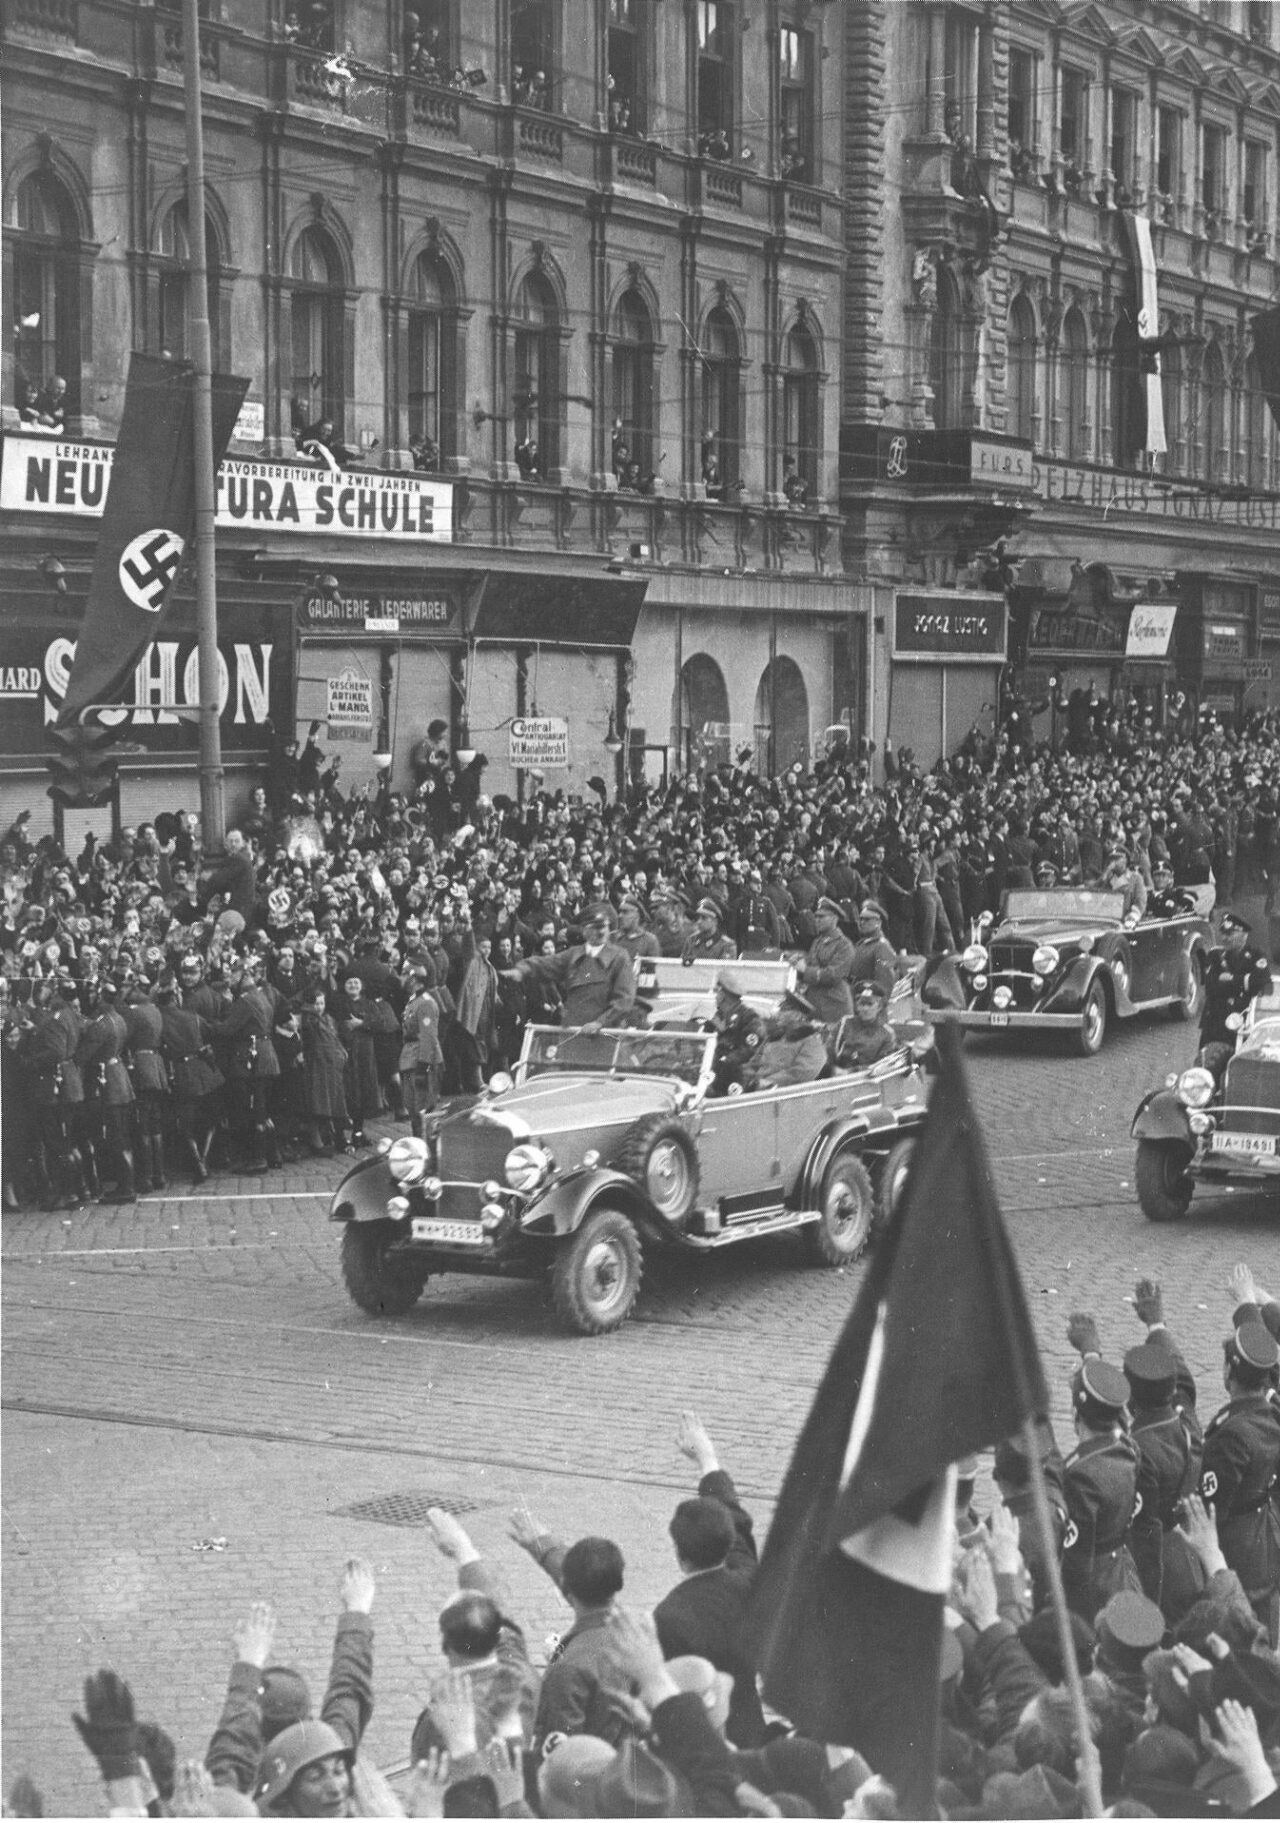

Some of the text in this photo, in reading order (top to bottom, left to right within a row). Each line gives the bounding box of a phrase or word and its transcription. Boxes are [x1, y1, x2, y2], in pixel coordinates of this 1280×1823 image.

[980, 451, 1024, 476] FURS
[331, 474, 342, 485] IN
[348, 475, 374, 489] ZWEI
[379, 478, 421, 493] JAHREN
[25, 456, 104, 507] NEU
[315, 485, 435, 534] SCHULE
[44, 637, 273, 726] SHON
[329, 681, 370, 691] GESCHENK
[332, 691, 367, 702] ARTIKEL
